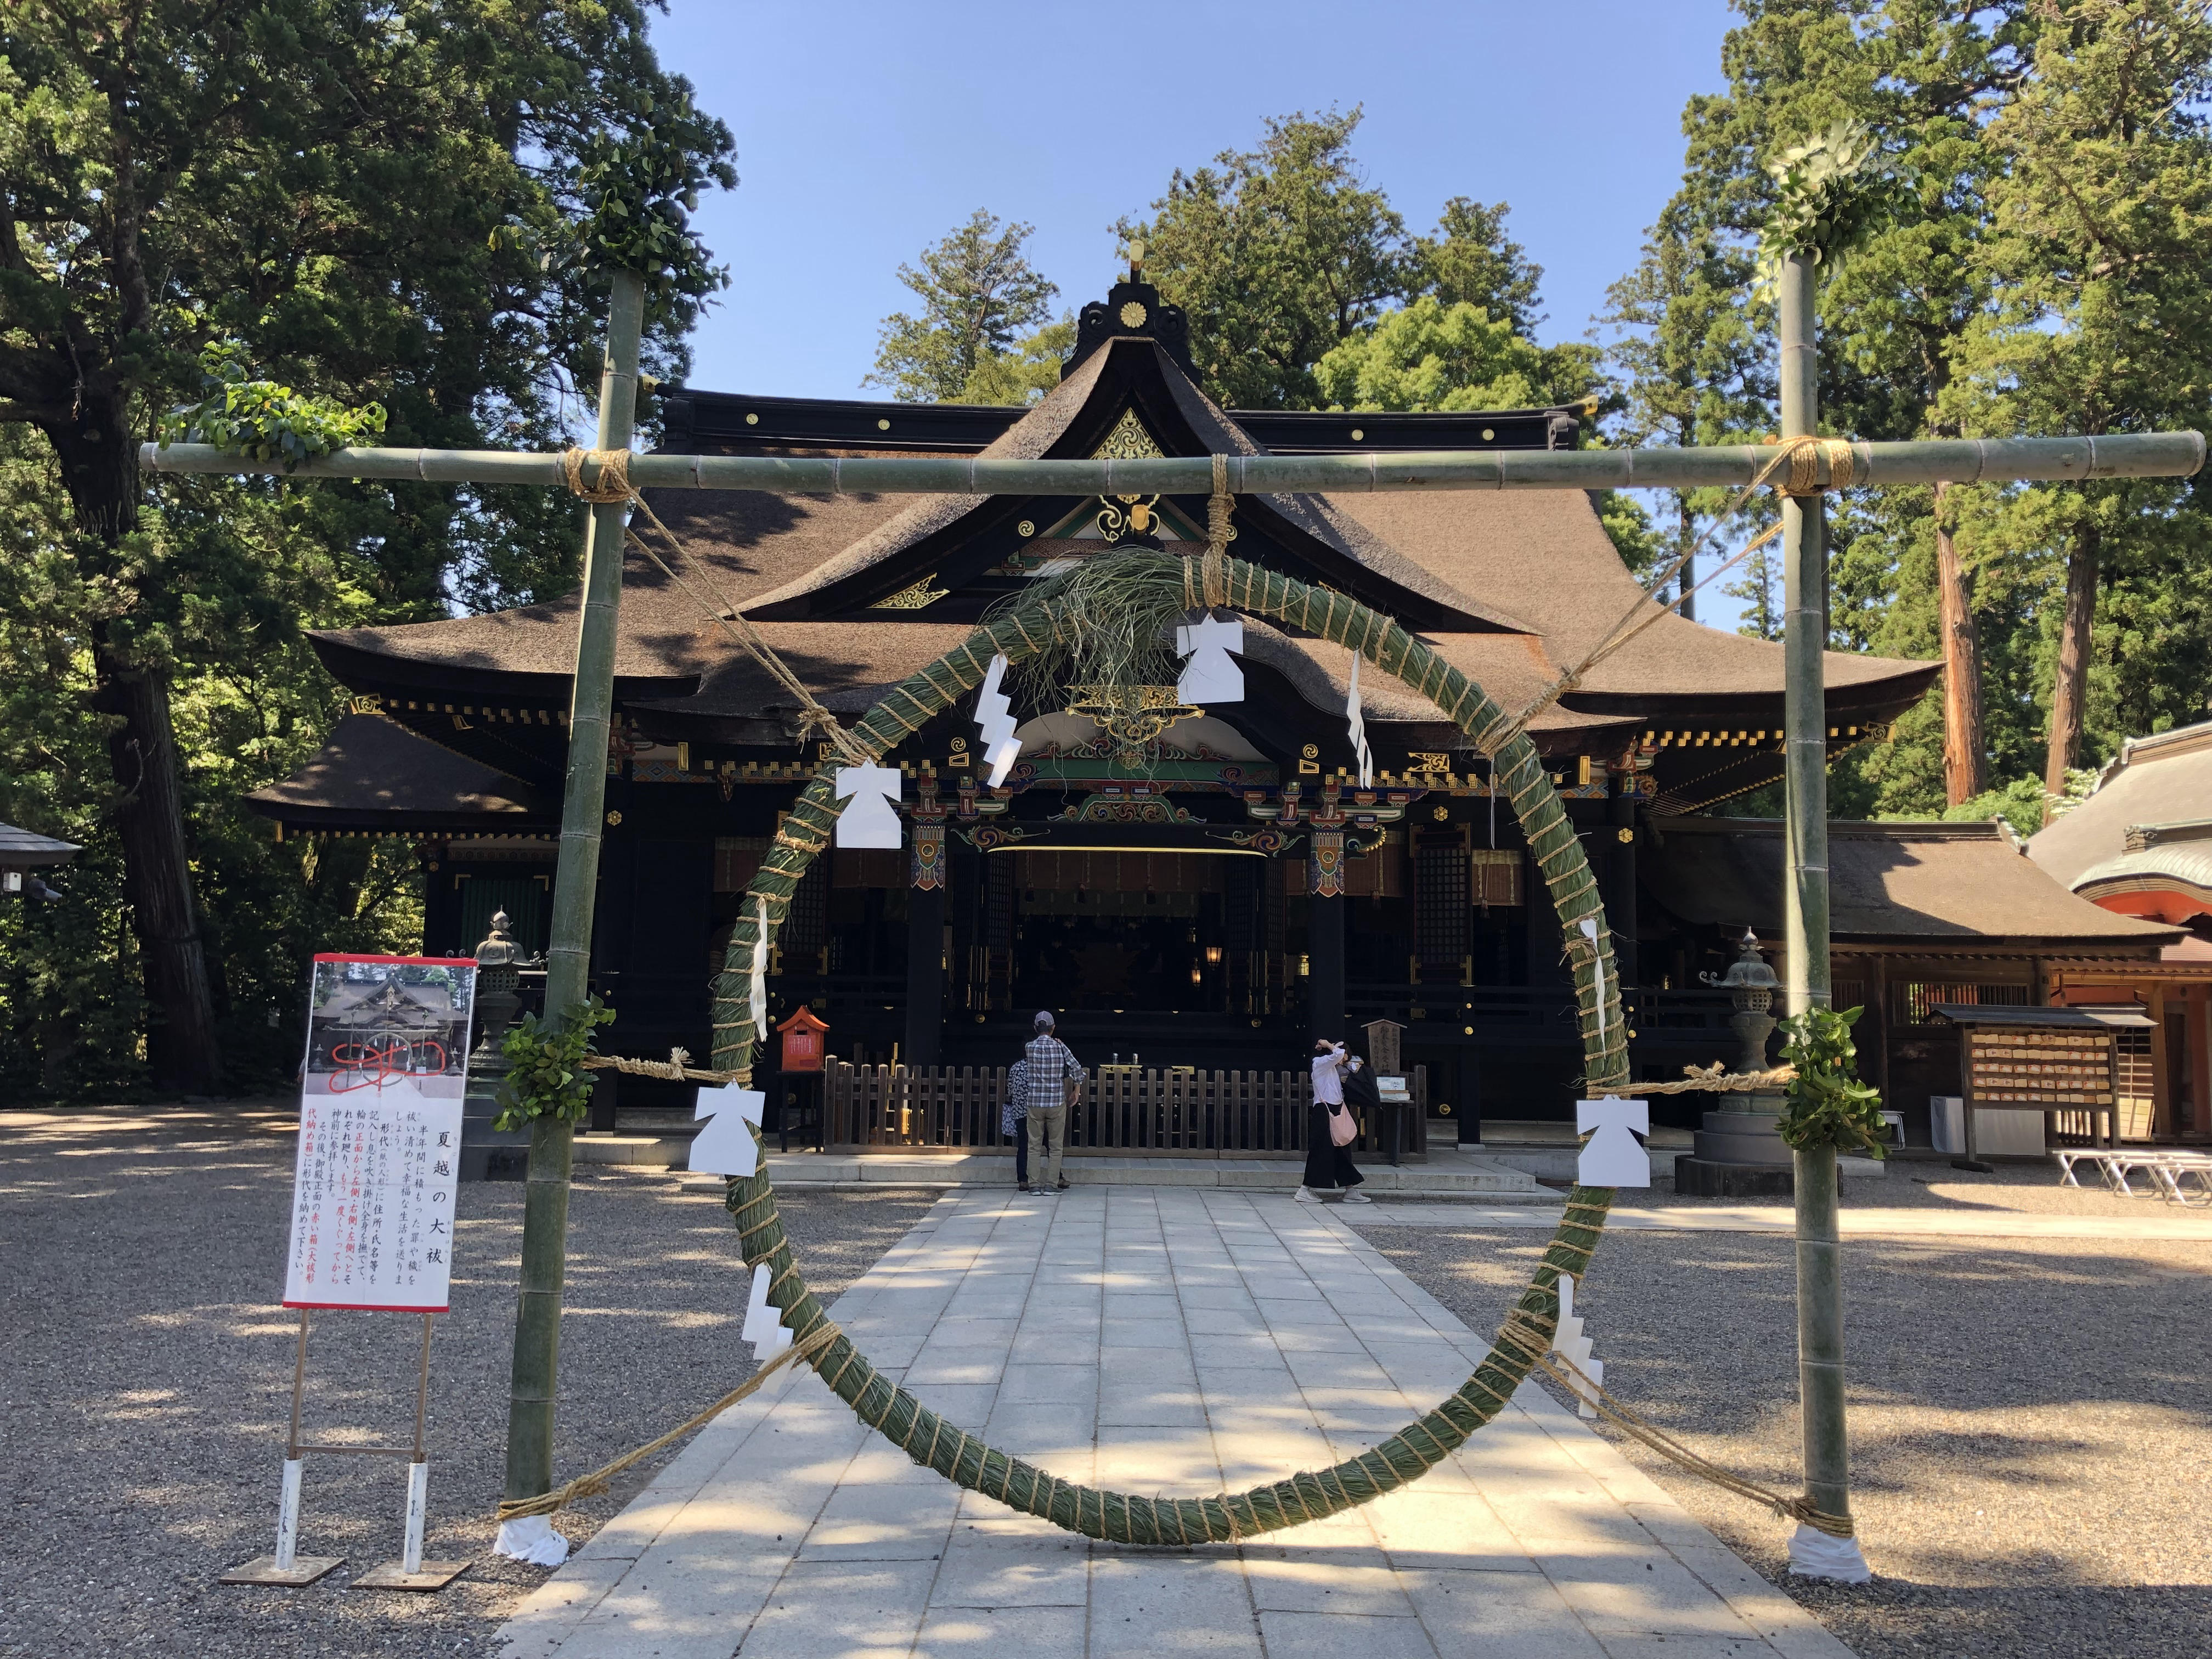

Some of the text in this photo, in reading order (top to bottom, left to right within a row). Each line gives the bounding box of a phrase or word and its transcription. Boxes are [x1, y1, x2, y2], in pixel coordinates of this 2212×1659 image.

[328, 1109, 341, 1197] 神前に参拝します。
[331, 1109, 353, 1284] れぞれ廻り、もう一度くぐってから
[345, 1110, 366, 1284] 輪の正面から左側・右側・左側へとそ
[358, 1110, 379, 1280] 記入し息を吹き掛け全身を撫でて、
[395, 1111, 416, 1284] 祓い清めて幸福な生活を送りま
[409, 1125, 428, 1285] 半年間に積もった罪や穢を
[426, 1131, 451, 1264] 夏越の大祓
